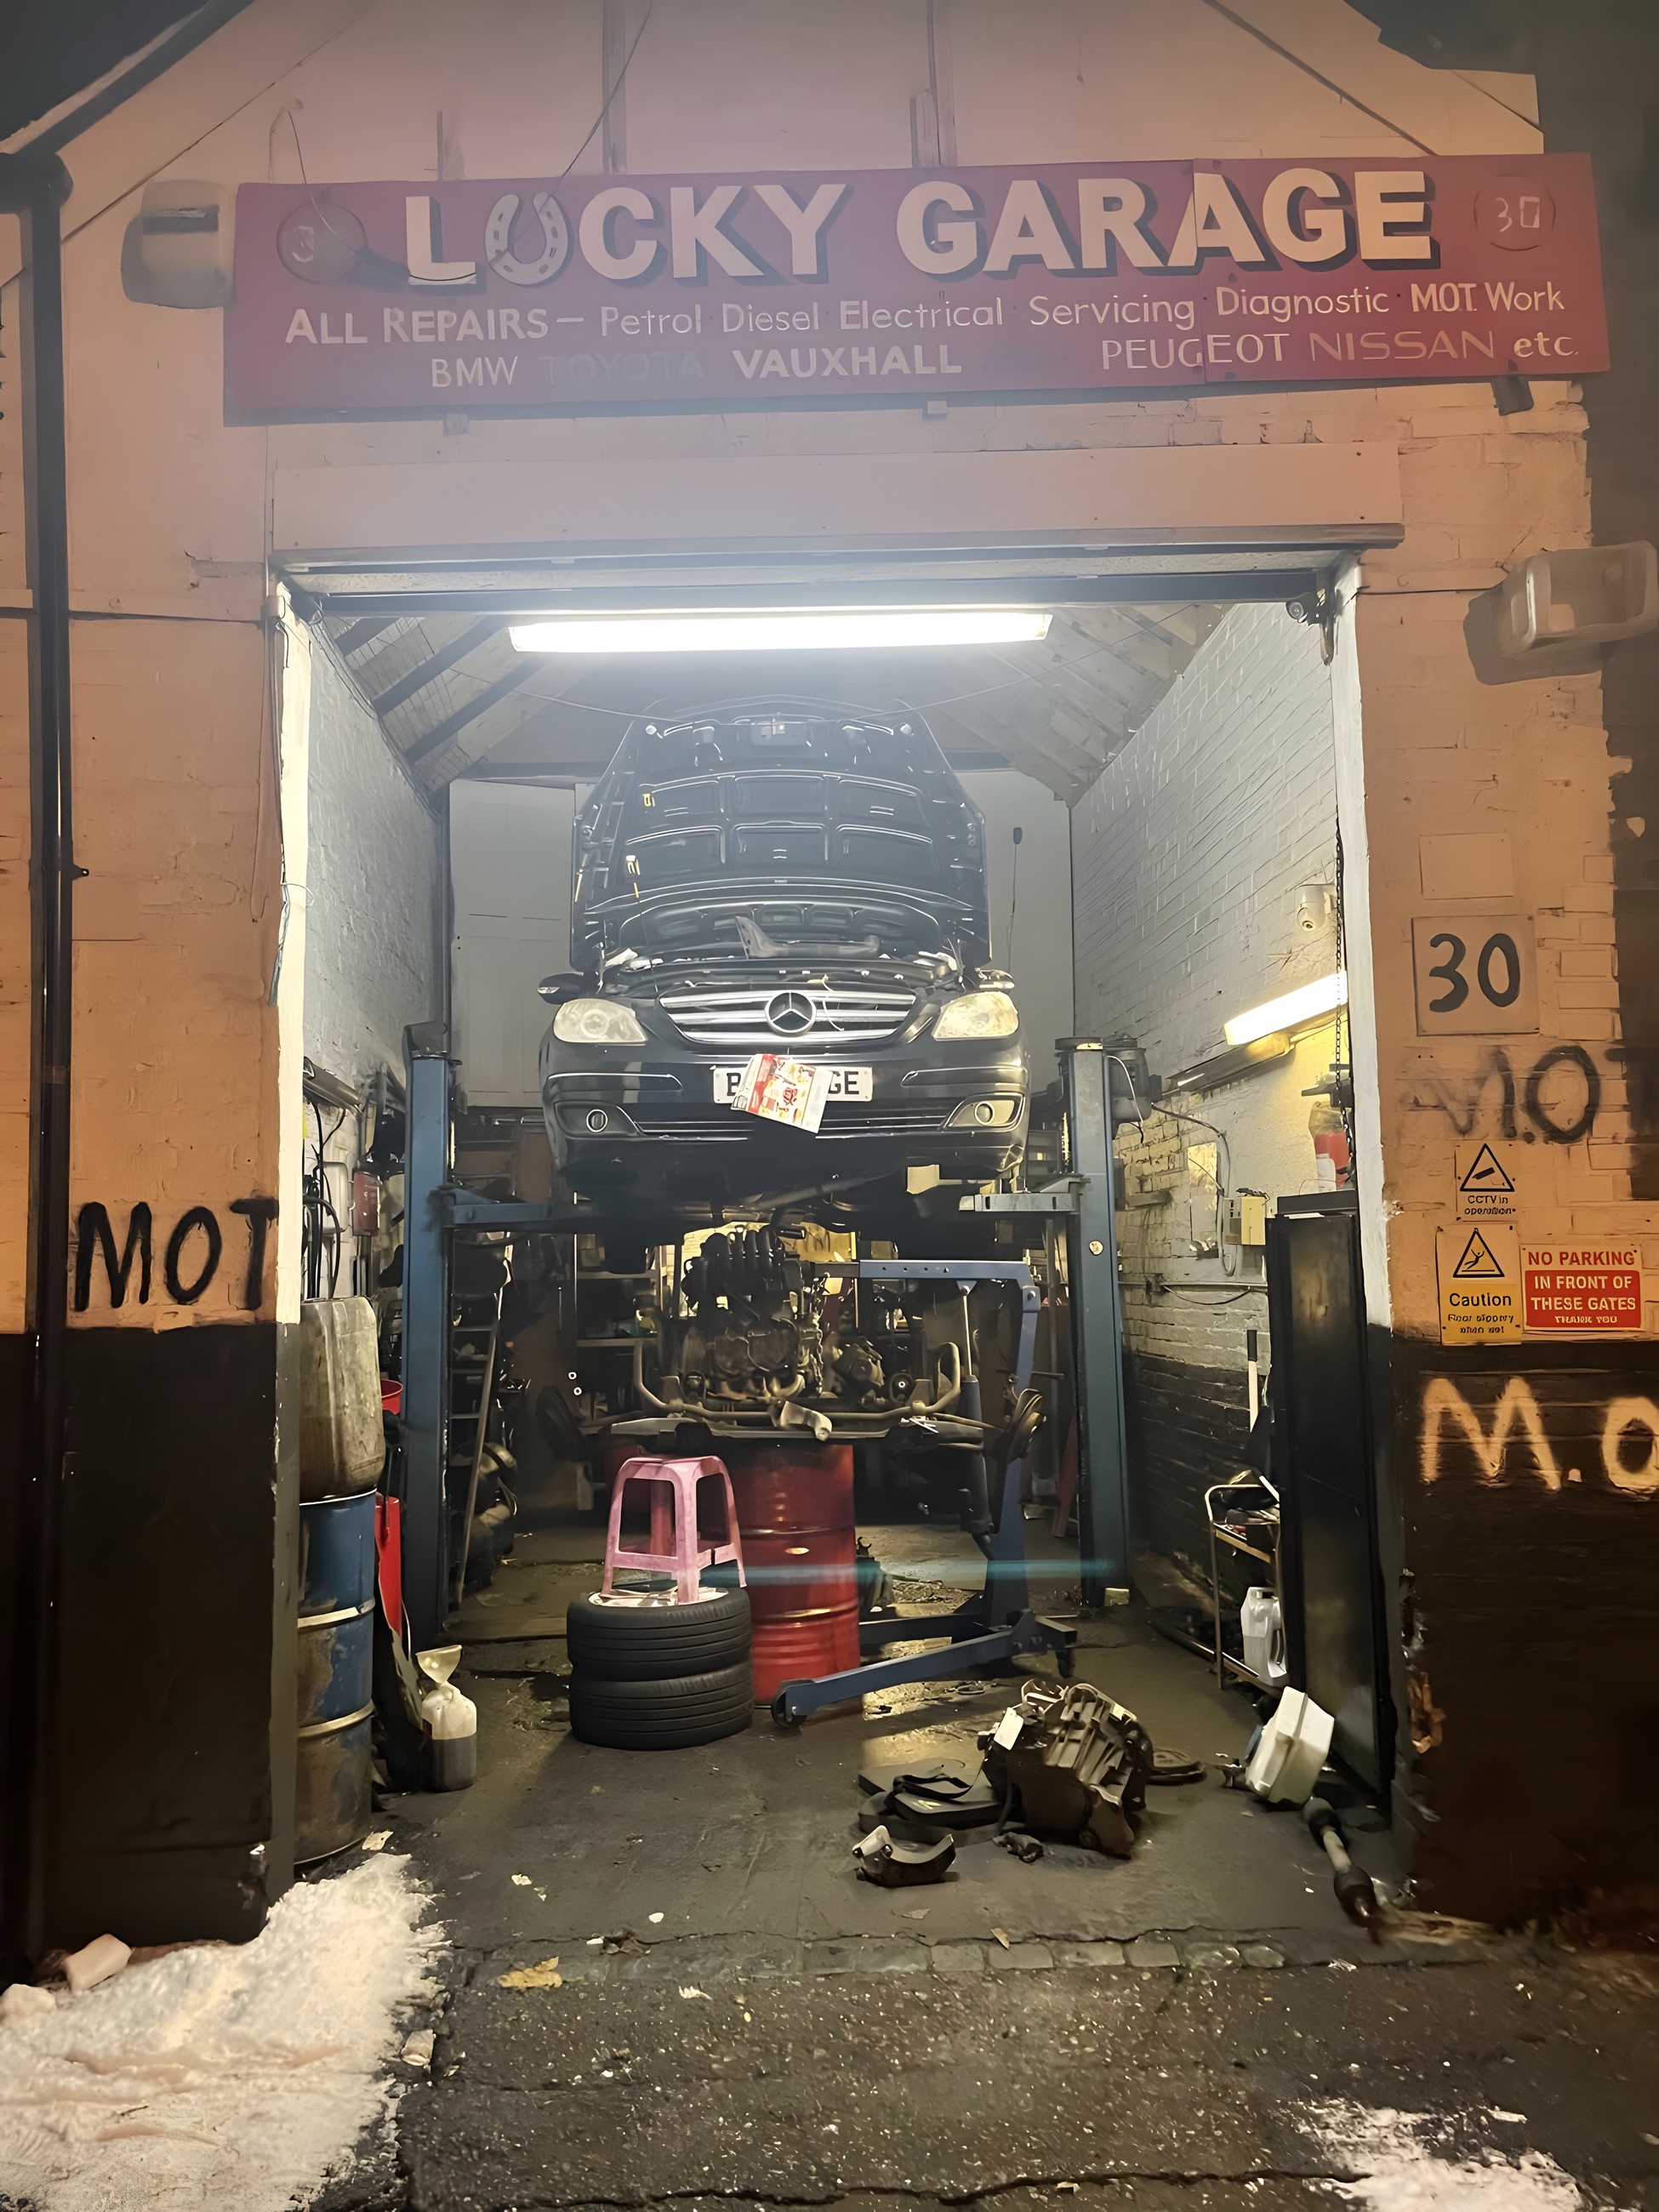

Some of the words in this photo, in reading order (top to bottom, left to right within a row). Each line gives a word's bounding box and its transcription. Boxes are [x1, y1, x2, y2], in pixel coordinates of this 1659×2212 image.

[405, 182, 849, 288] LUCKY
[897, 168, 1432, 275] GARAGE
[285, 308, 368, 345] ALL
[383, 307, 549, 343] REPAIRS
[601, 303, 701, 336] Petrol
[721, 301, 819, 333] Diesel
[840, 297, 1003, 330] Electrical
[1029, 294, 1195, 330] Servicing
[1216, 286, 1390, 322] Diagnostic
[1484, 281, 1565, 312] Work
[430, 356, 518, 388] BMW
[538, 351, 707, 385] TOYOTA
[732, 345, 962, 379] VAUXHALL
[1102, 333, 1290, 370] PEUGEOT
[1308, 330, 1495, 362] NISSAN
[1428, 932, 1521, 1013] 30
[1468, 1194, 1497, 1204] CCTV
[1499, 1194, 1508, 1204] in
[75, 1195, 279, 1312] MOT
[1528, 1251, 1553, 1266] NO
[1559, 1251, 1635, 1266] PARKING
[1449, 1292, 1512, 1307] Caution
[1534, 1275, 1551, 1290] IN
[1556, 1275, 1608, 1290] FRONT
[1612, 1275, 1633, 1289] OF
[1531, 1297, 1582, 1311] THESE
[1588, 1297, 1636, 1311] GATES
